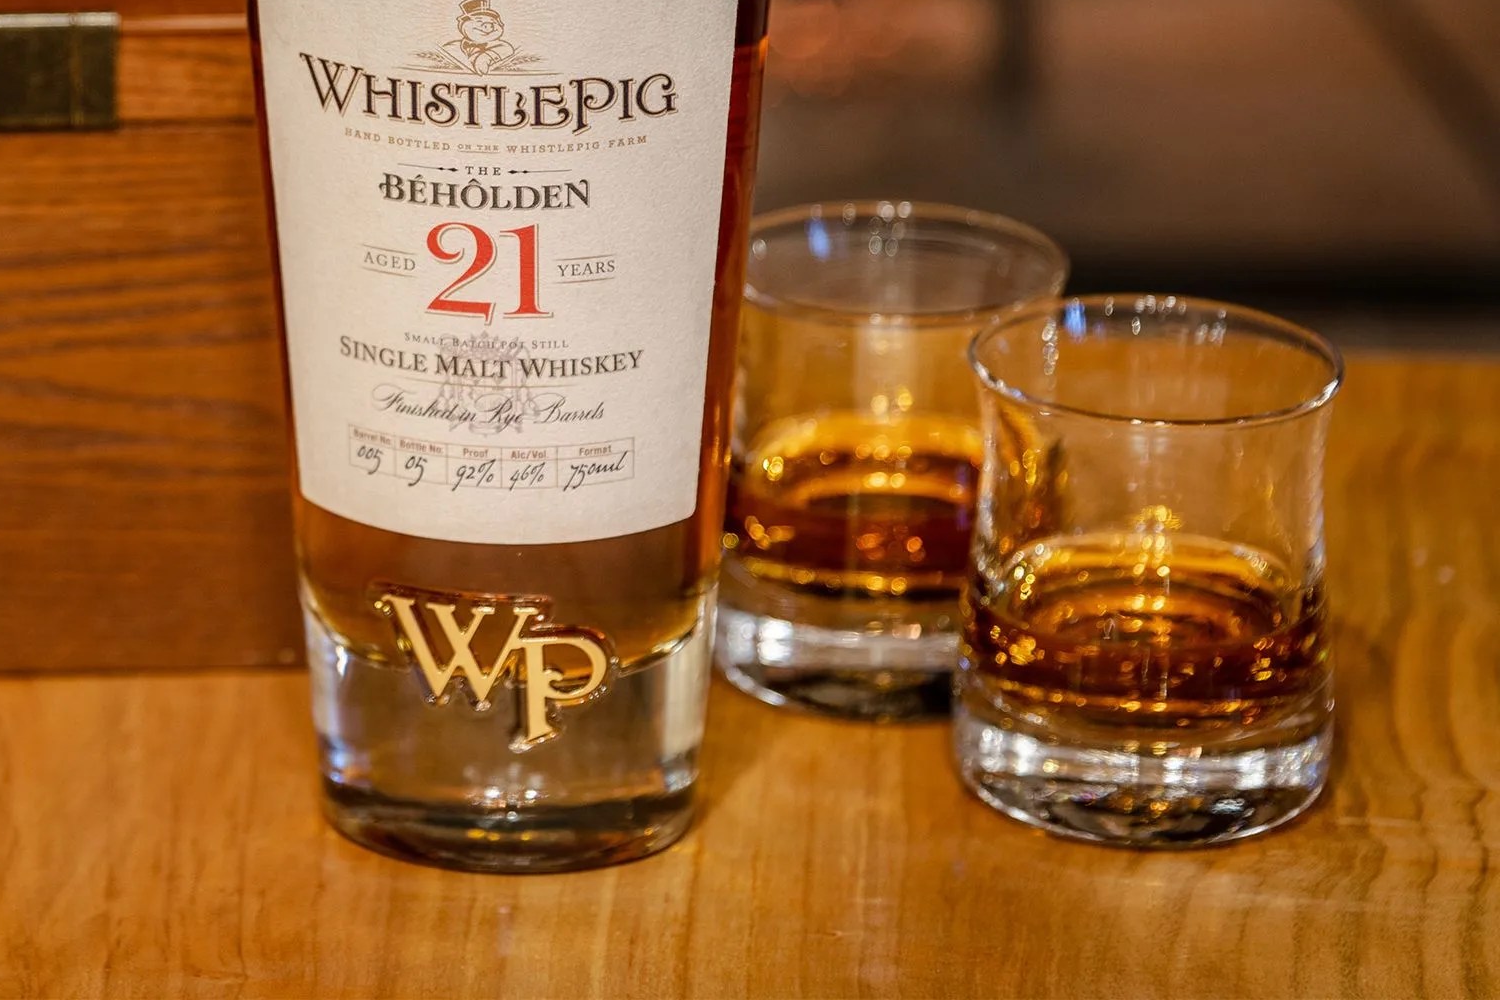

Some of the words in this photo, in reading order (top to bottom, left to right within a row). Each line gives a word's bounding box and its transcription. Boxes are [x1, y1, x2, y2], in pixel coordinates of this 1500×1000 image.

[299, 51, 680, 137] WHISTLEPIG
[344, 126, 381, 143] HAND
[388, 135, 451, 151] BOTTLED
[476, 144, 500, 152] THE
[506, 141, 600, 154] WHISTLEPIG
[608, 135, 648, 149] FARM
[465, 165, 502, 176] THE
[378, 171, 592, 212] BÉHÔLDEN
[363, 251, 417, 272] AGED
[425, 221, 555, 327] 21
[556, 259, 616, 278] YEARS
[339, 335, 428, 373] SINGLE
[435, 352, 512, 379] MALT
[519, 349, 645, 379] WHISKEY
[371, 382, 458, 420] Finished
[459, 407, 477, 424] in
[474, 392, 524, 433] Rye
[528, 392, 605, 425] Barrels
[357, 445, 384, 476] 005
[399, 438, 427, 452] Bottle
[462, 447, 489, 459] Proof
[578, 444, 613, 457] Format
[404, 455, 428, 487] 05
[451, 458, 497, 492] 92%
[509, 461, 546, 492] 46%
